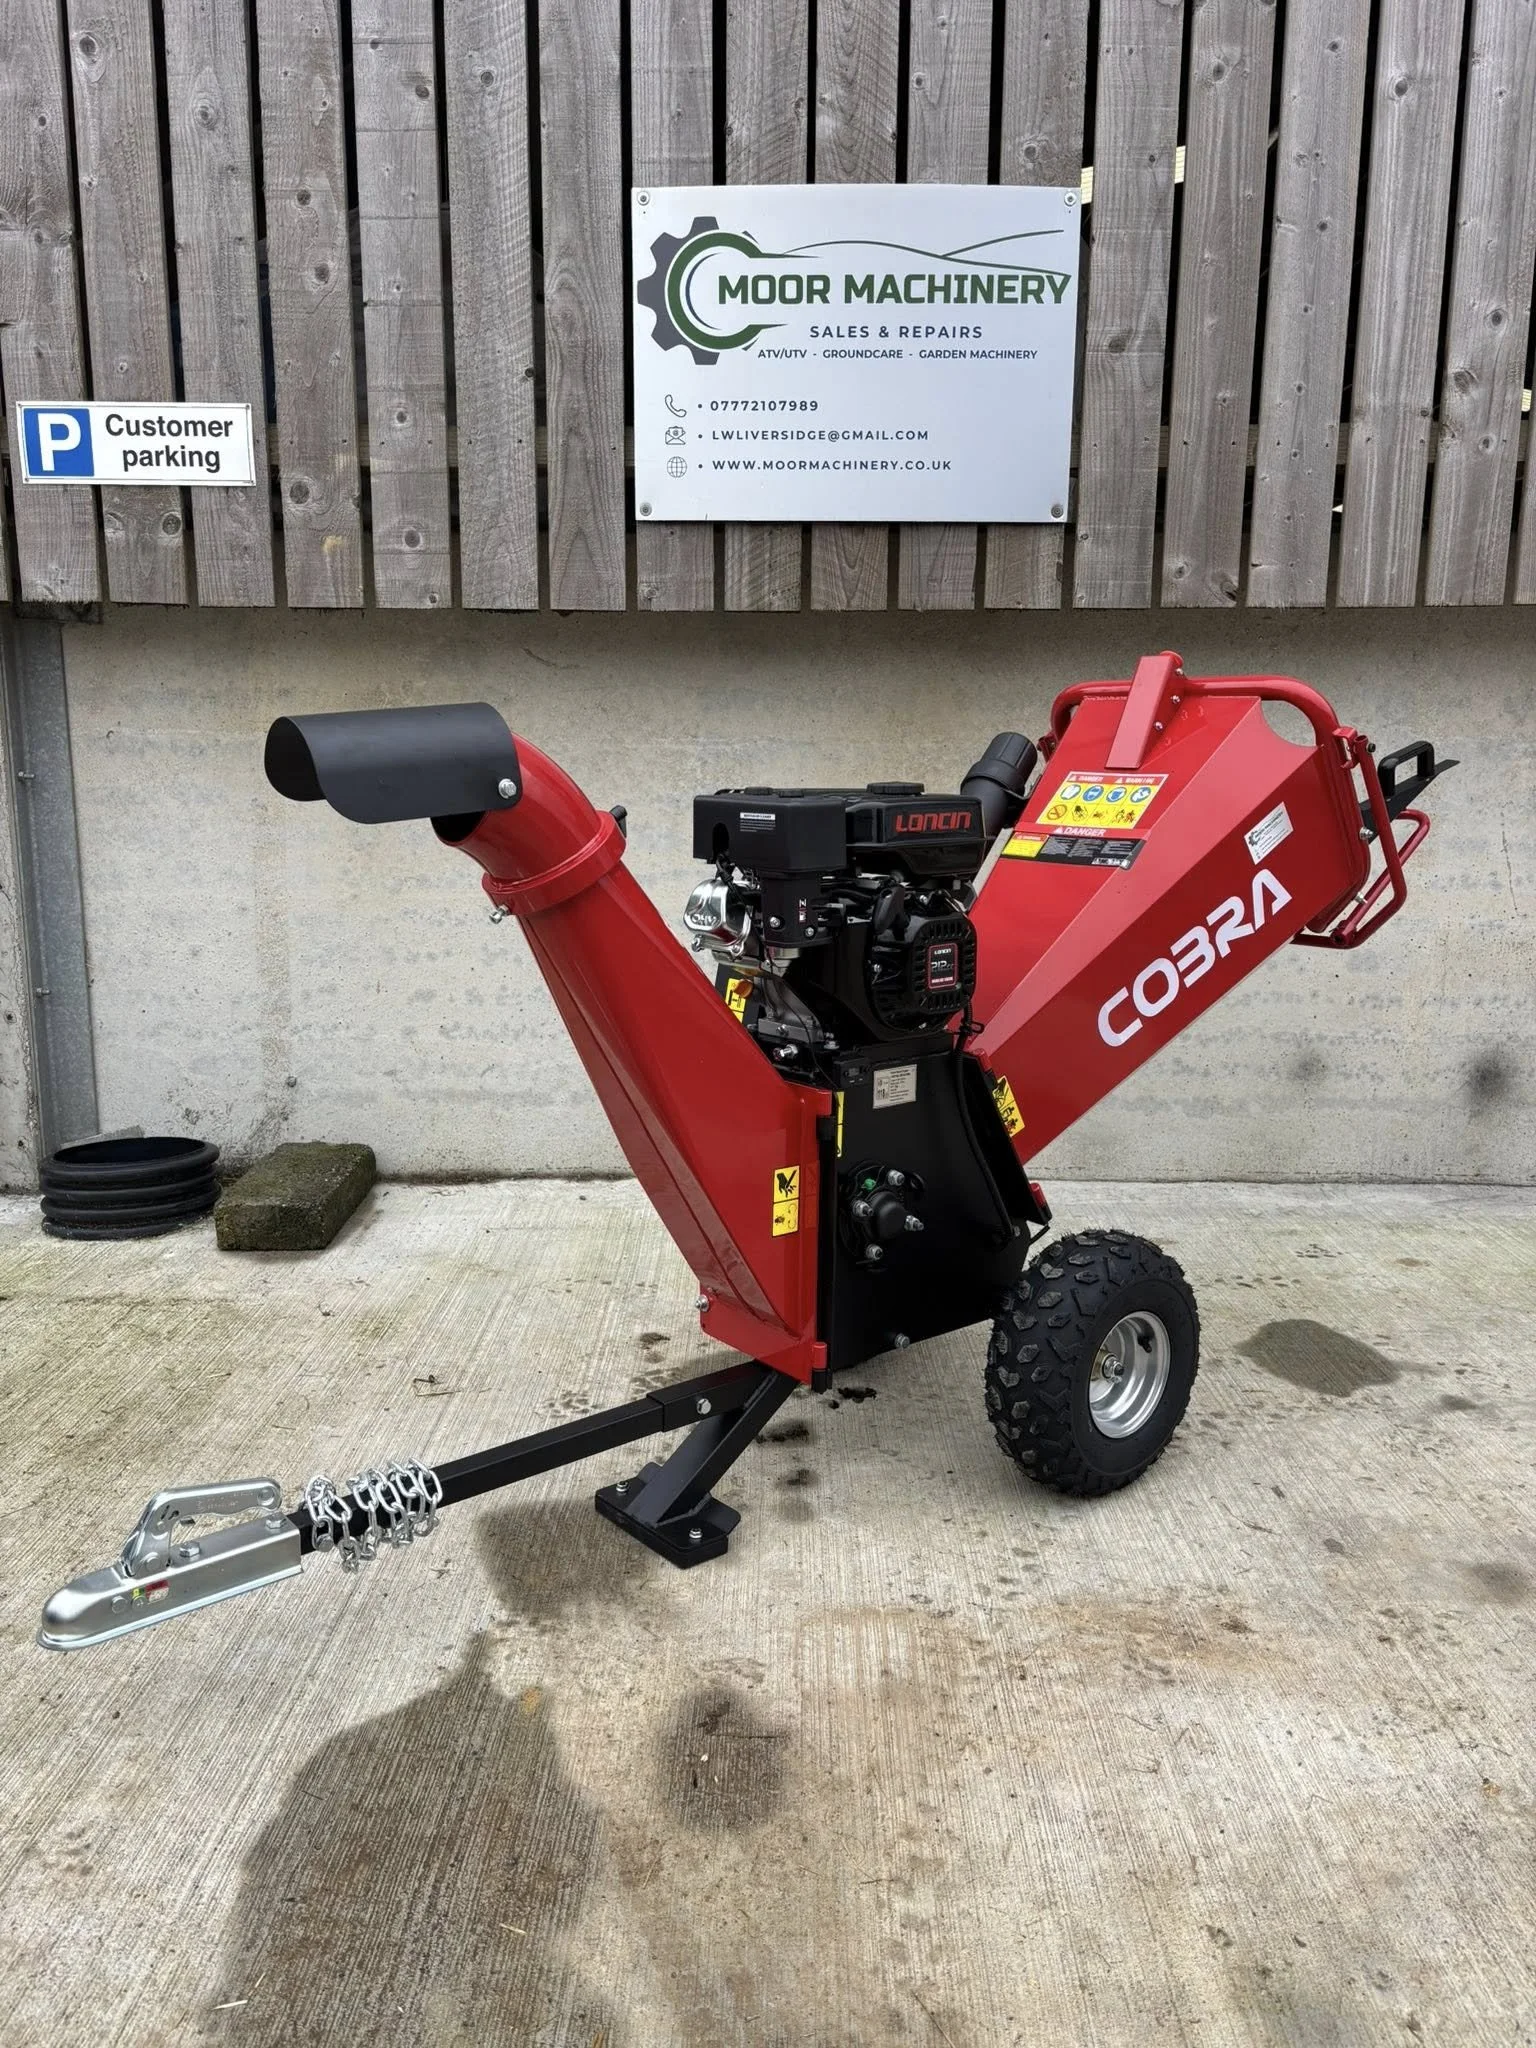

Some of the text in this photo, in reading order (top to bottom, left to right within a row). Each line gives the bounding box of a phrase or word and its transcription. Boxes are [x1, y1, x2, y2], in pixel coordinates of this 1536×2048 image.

[718, 274, 1071, 304] MOOR MACHINERY
[810, 326, 982, 338] SALES & REPAIRS
[758, 348, 807, 359] ATV/UTV
[823, 349, 903, 358] GROUNDCARE
[919, 350, 966, 359] GARDEN
[970, 349, 1037, 359] MACHINERY
[710, 400, 818, 411] 07772107989
[106, 414, 233, 437] Customer
[38, 413, 81, 471] P
[713, 430, 928, 442] LWLIVERSIDGE@GMAIL.COM
[123, 446, 220, 472] parking
[712, 460, 951, 472] WWW.MOORMACHINERY.CO.UK
[1064, 827, 1106, 837] DANGER
[1098, 869, 1292, 1047] COBRA
